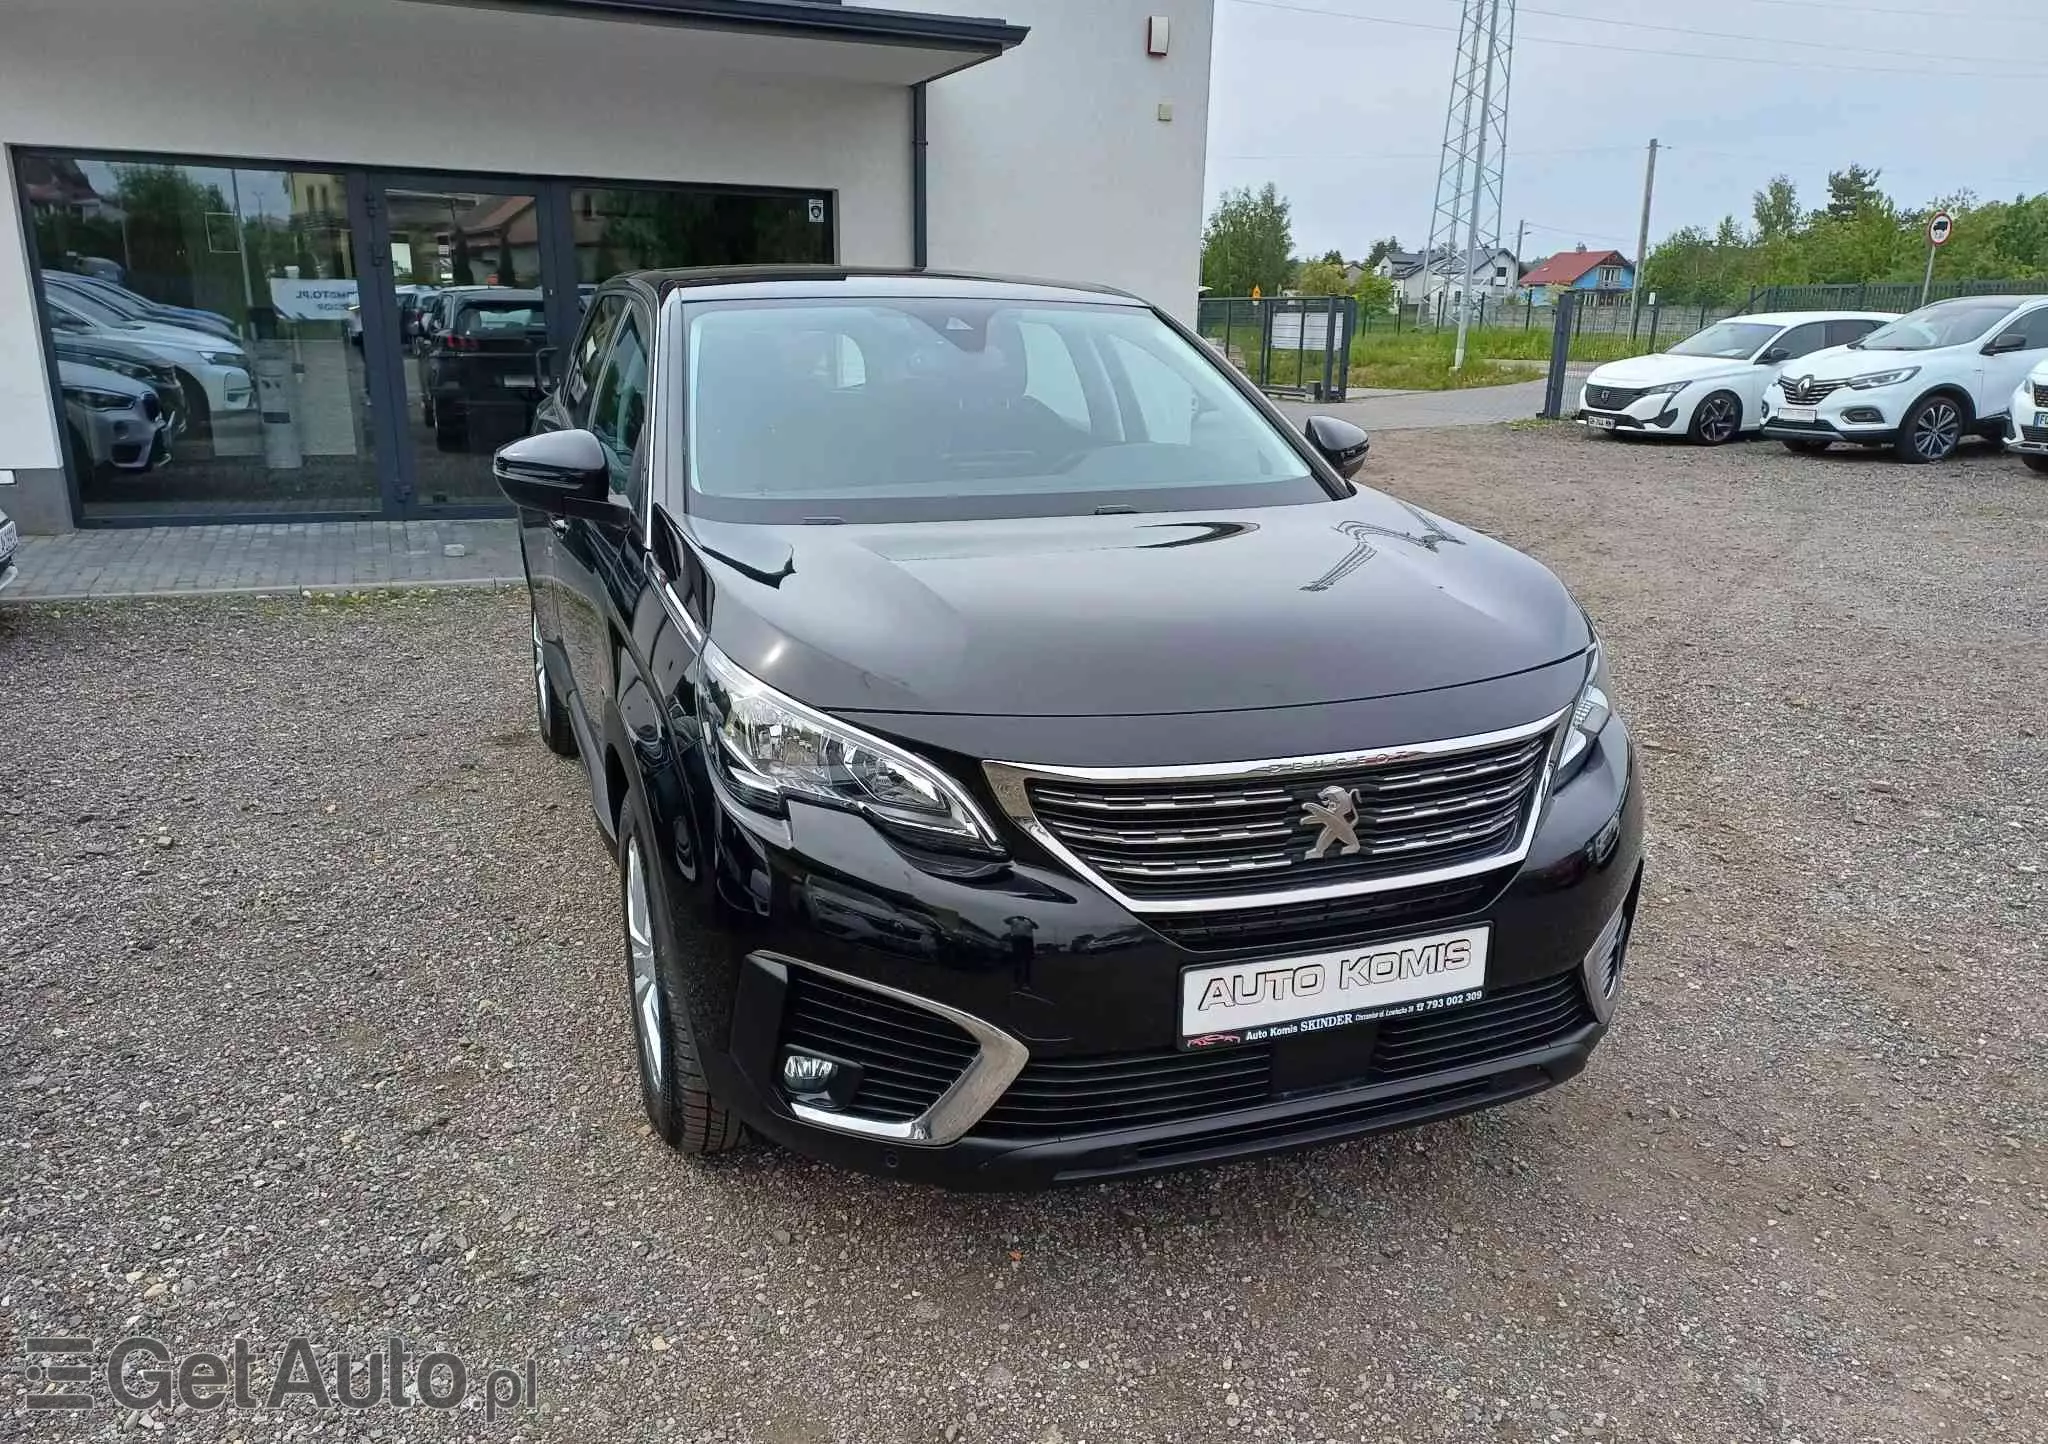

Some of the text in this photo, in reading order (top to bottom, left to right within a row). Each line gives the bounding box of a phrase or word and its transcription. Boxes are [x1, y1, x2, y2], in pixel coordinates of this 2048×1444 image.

[1198, 939, 1472, 1011] AUTO KOMIS
[1246, 1030, 1268, 1041] Auto
[1270, 1024, 1298, 1037] Komis
[1300, 1013, 1353, 1032] SKINDER
[1426, 999, 1444, 1010] 793
[1446, 994, 1464, 1006] 002
[1465, 990, 1483, 1002] 309
